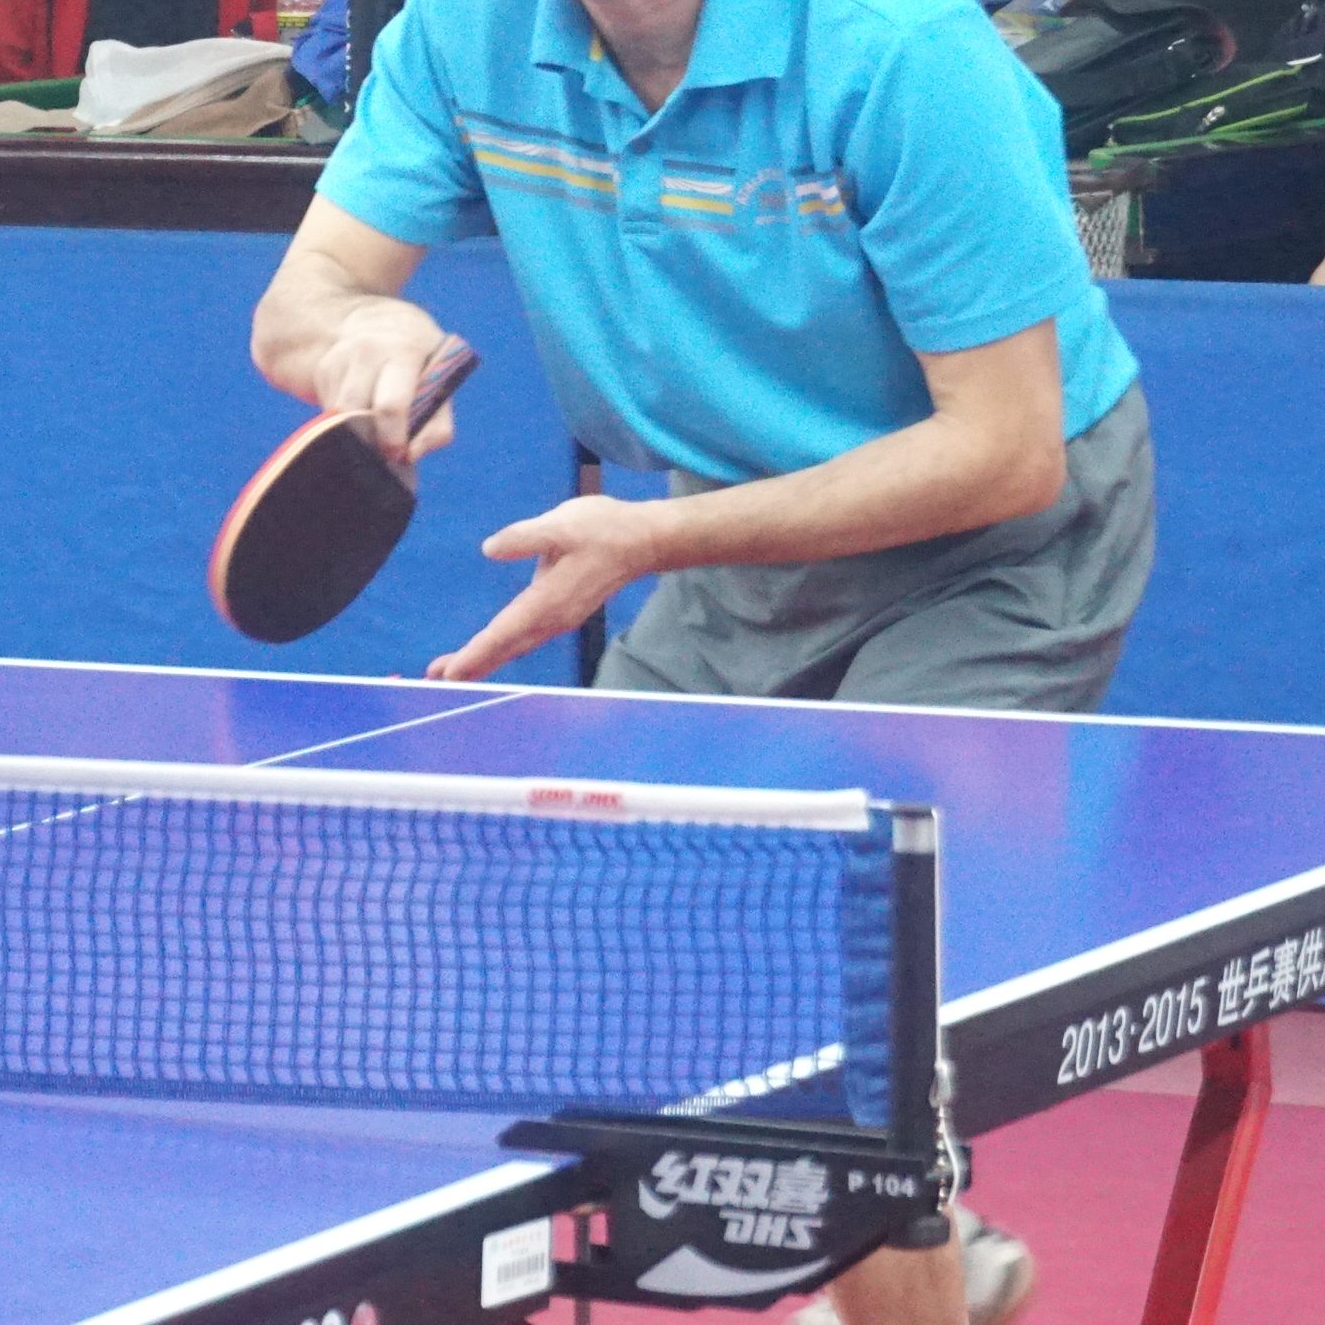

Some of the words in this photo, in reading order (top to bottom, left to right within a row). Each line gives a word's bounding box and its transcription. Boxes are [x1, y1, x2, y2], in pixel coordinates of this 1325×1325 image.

[638, 1149, 829, 1219] 红双喜
[847, 1170, 866, 1193] P
[873, 1173, 917, 1198] 104
[719, 1209, 822, 1250] DHS
